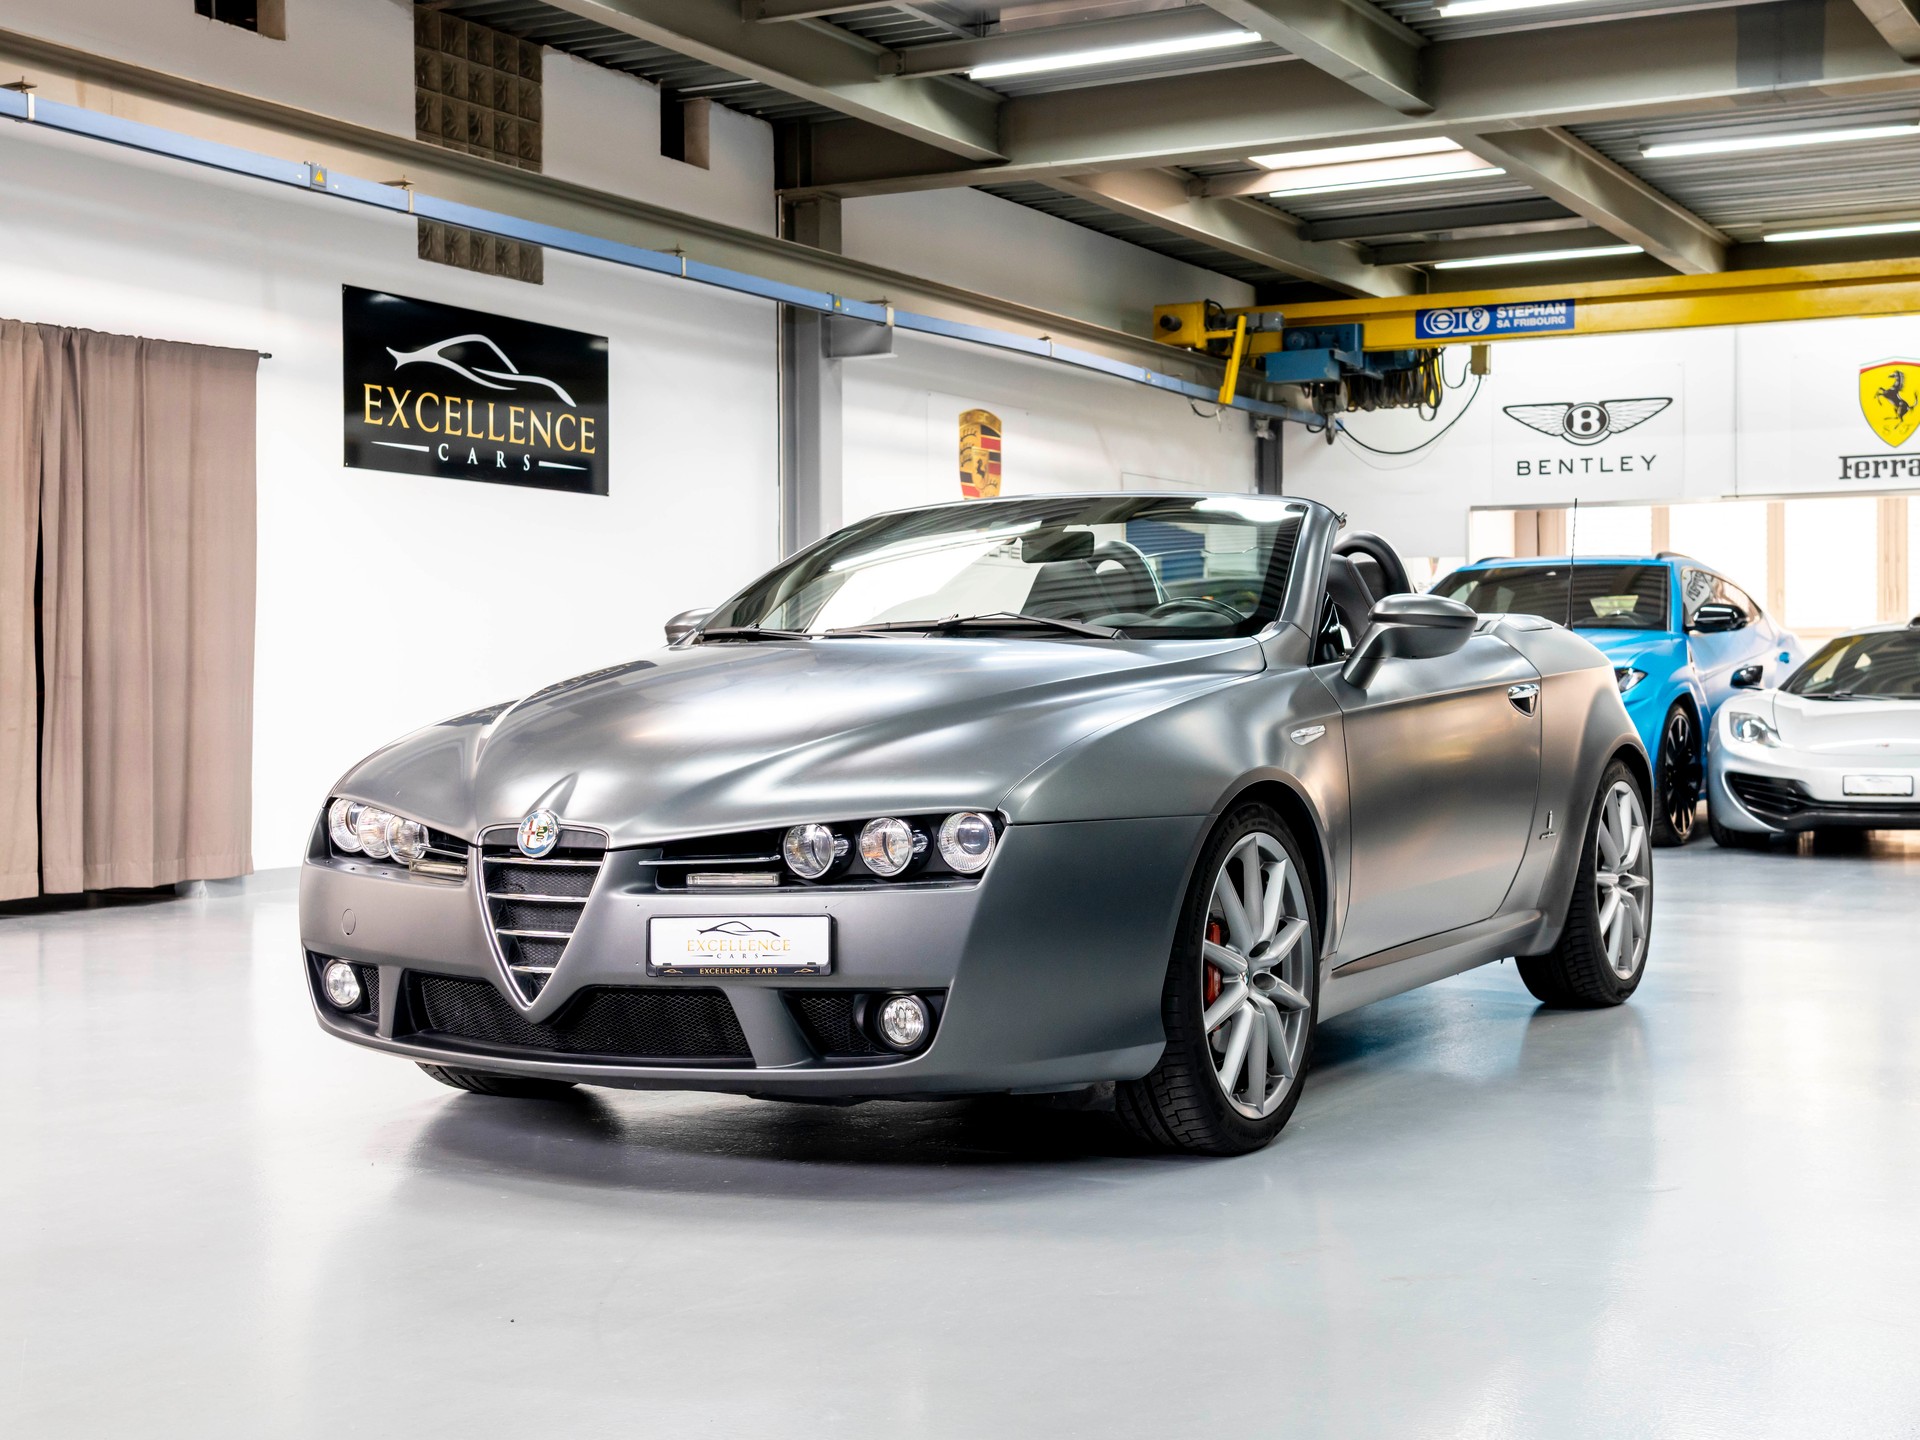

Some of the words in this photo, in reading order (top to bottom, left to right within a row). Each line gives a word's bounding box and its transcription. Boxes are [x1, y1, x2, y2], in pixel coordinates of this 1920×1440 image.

[1496, 302, 1567, 319] STEPHAN
[1496, 320, 1511, 329] SA
[1513, 315, 1566, 328] FRIBOURG
[363, 382, 596, 455] EXCELLENCE
[438, 443, 531, 471] CARS
[1516, 454, 1657, 476] BENTLEY
[687, 939, 791, 952] EXCELLENCE
[700, 967, 751, 975] EXCELLENCE
[755, 967, 778, 975] CARS
